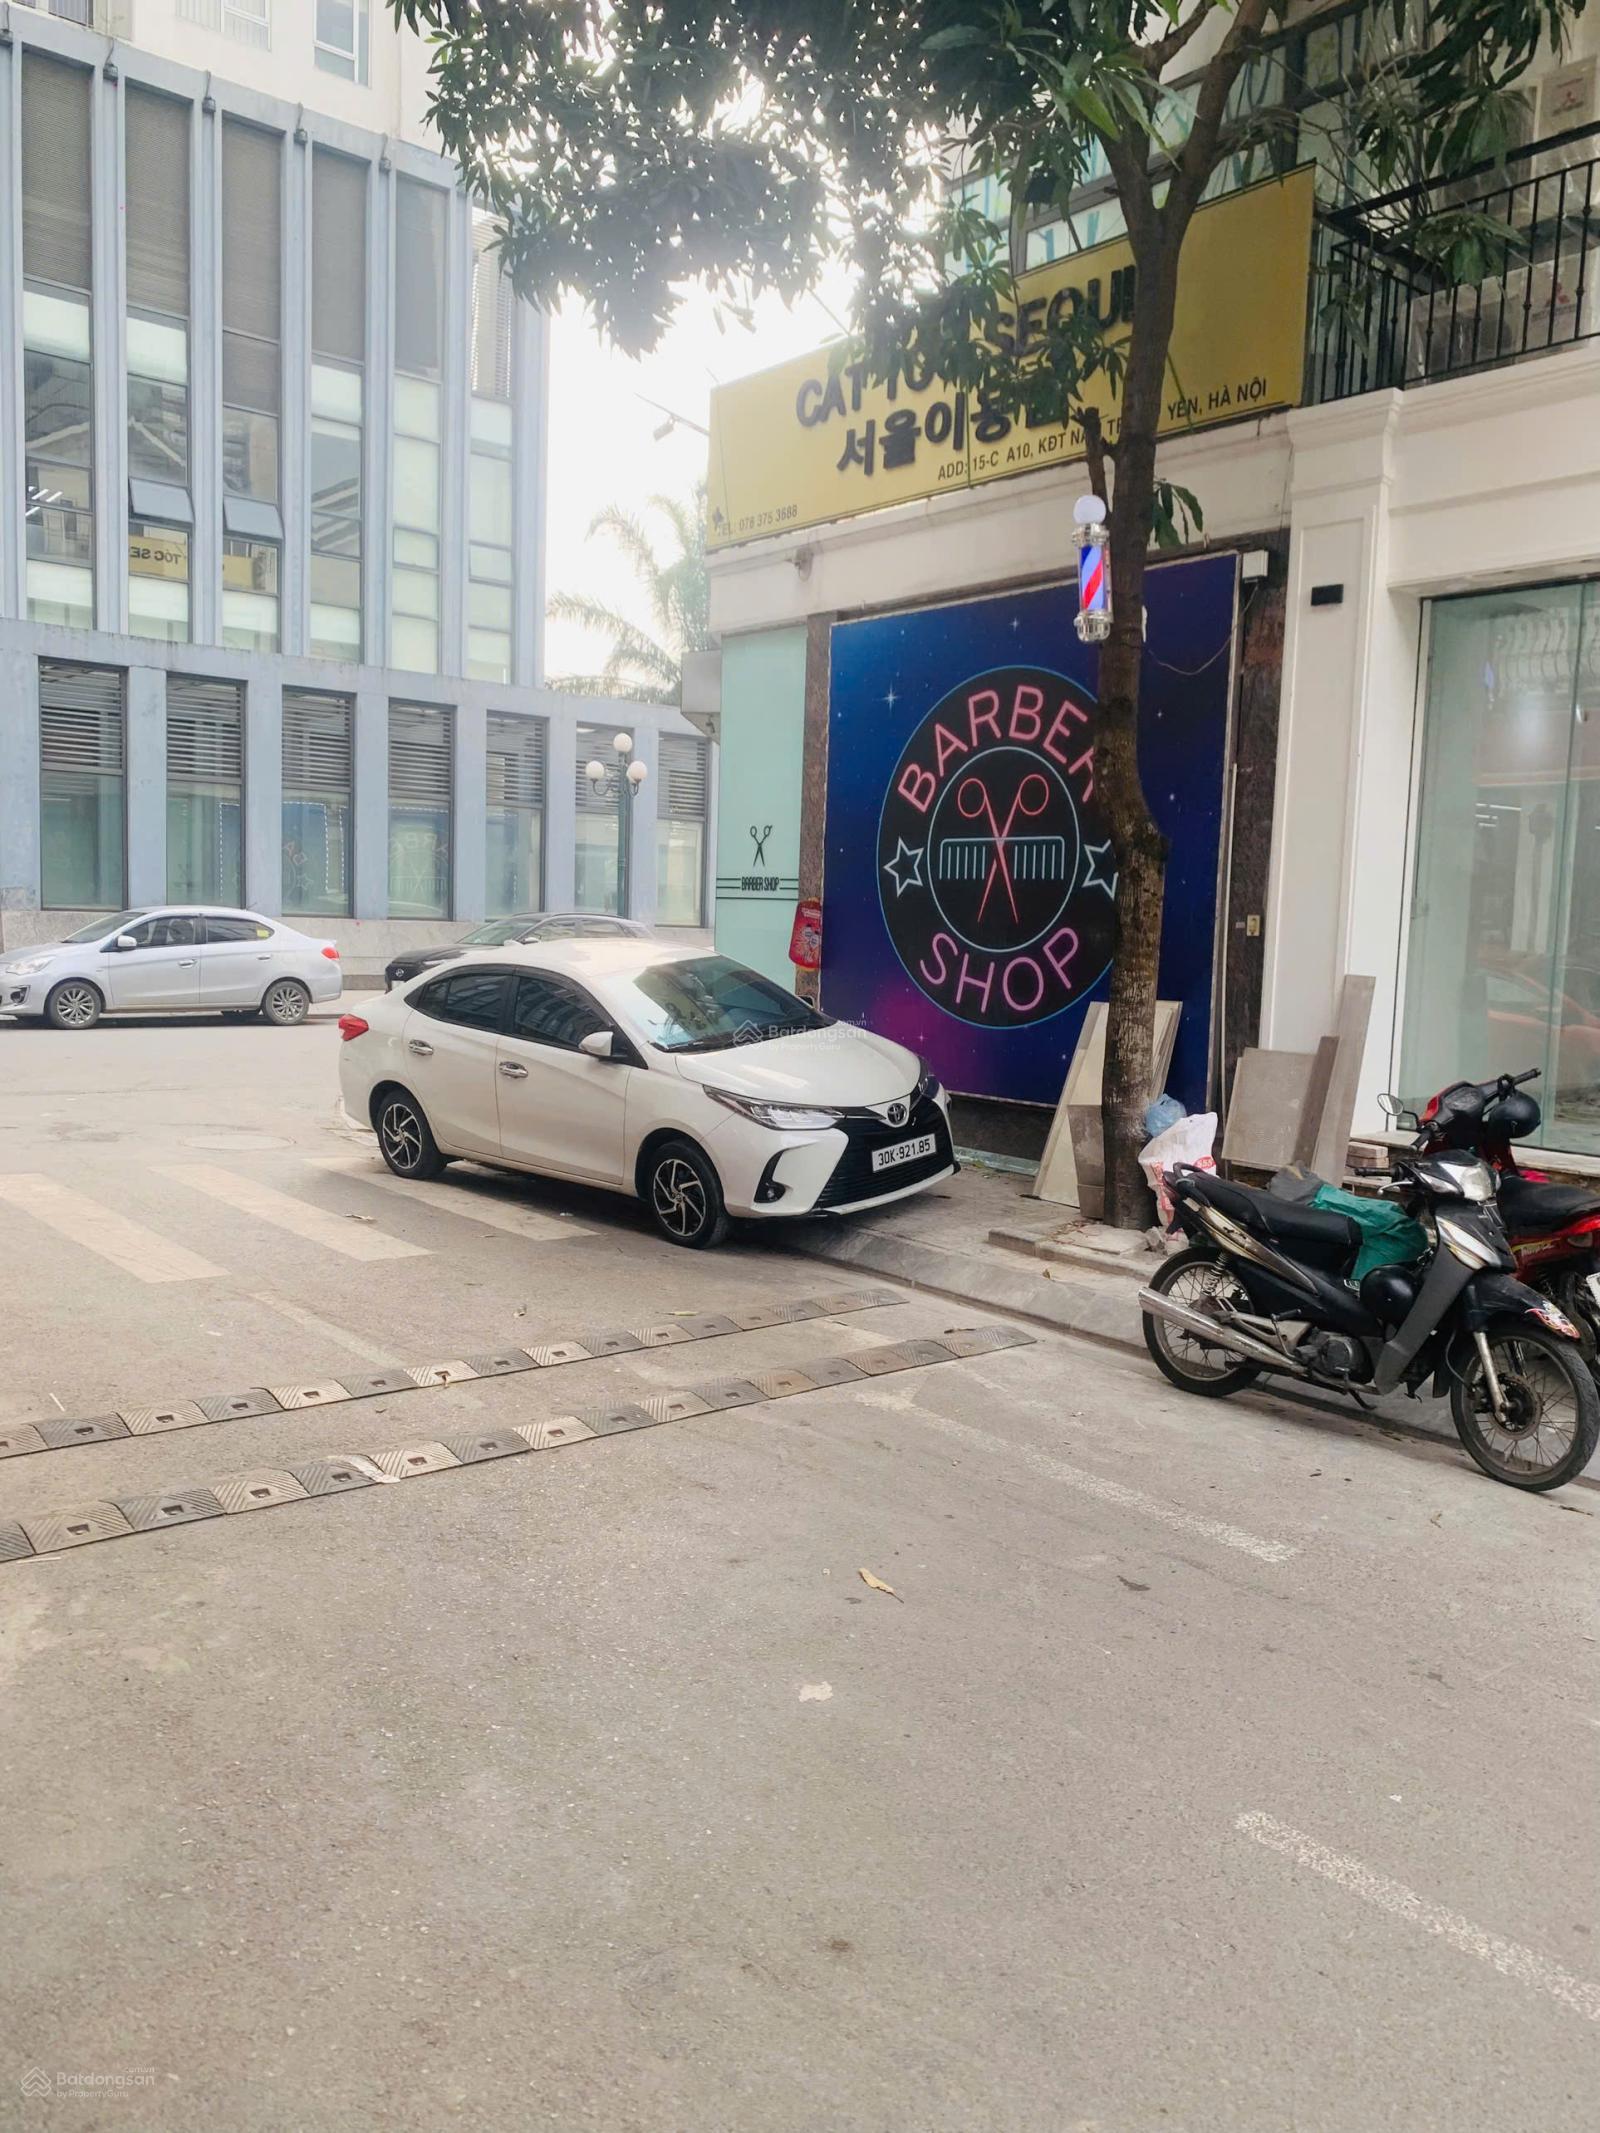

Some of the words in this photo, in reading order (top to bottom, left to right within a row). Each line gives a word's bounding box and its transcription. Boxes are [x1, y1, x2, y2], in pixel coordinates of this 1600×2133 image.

[837, 366, 1065, 476] 서울이용
[938, 461, 968, 481] ADD:
[972, 451, 999, 472] 15-C
[1006, 443, 1034, 463] A10,
[1038, 433, 1066, 455] KĐT
[1208, 384, 1231, 410] HÀ
[1236, 376, 1267, 403] NỘI
[919, 927, 1079, 1013] SHOP
